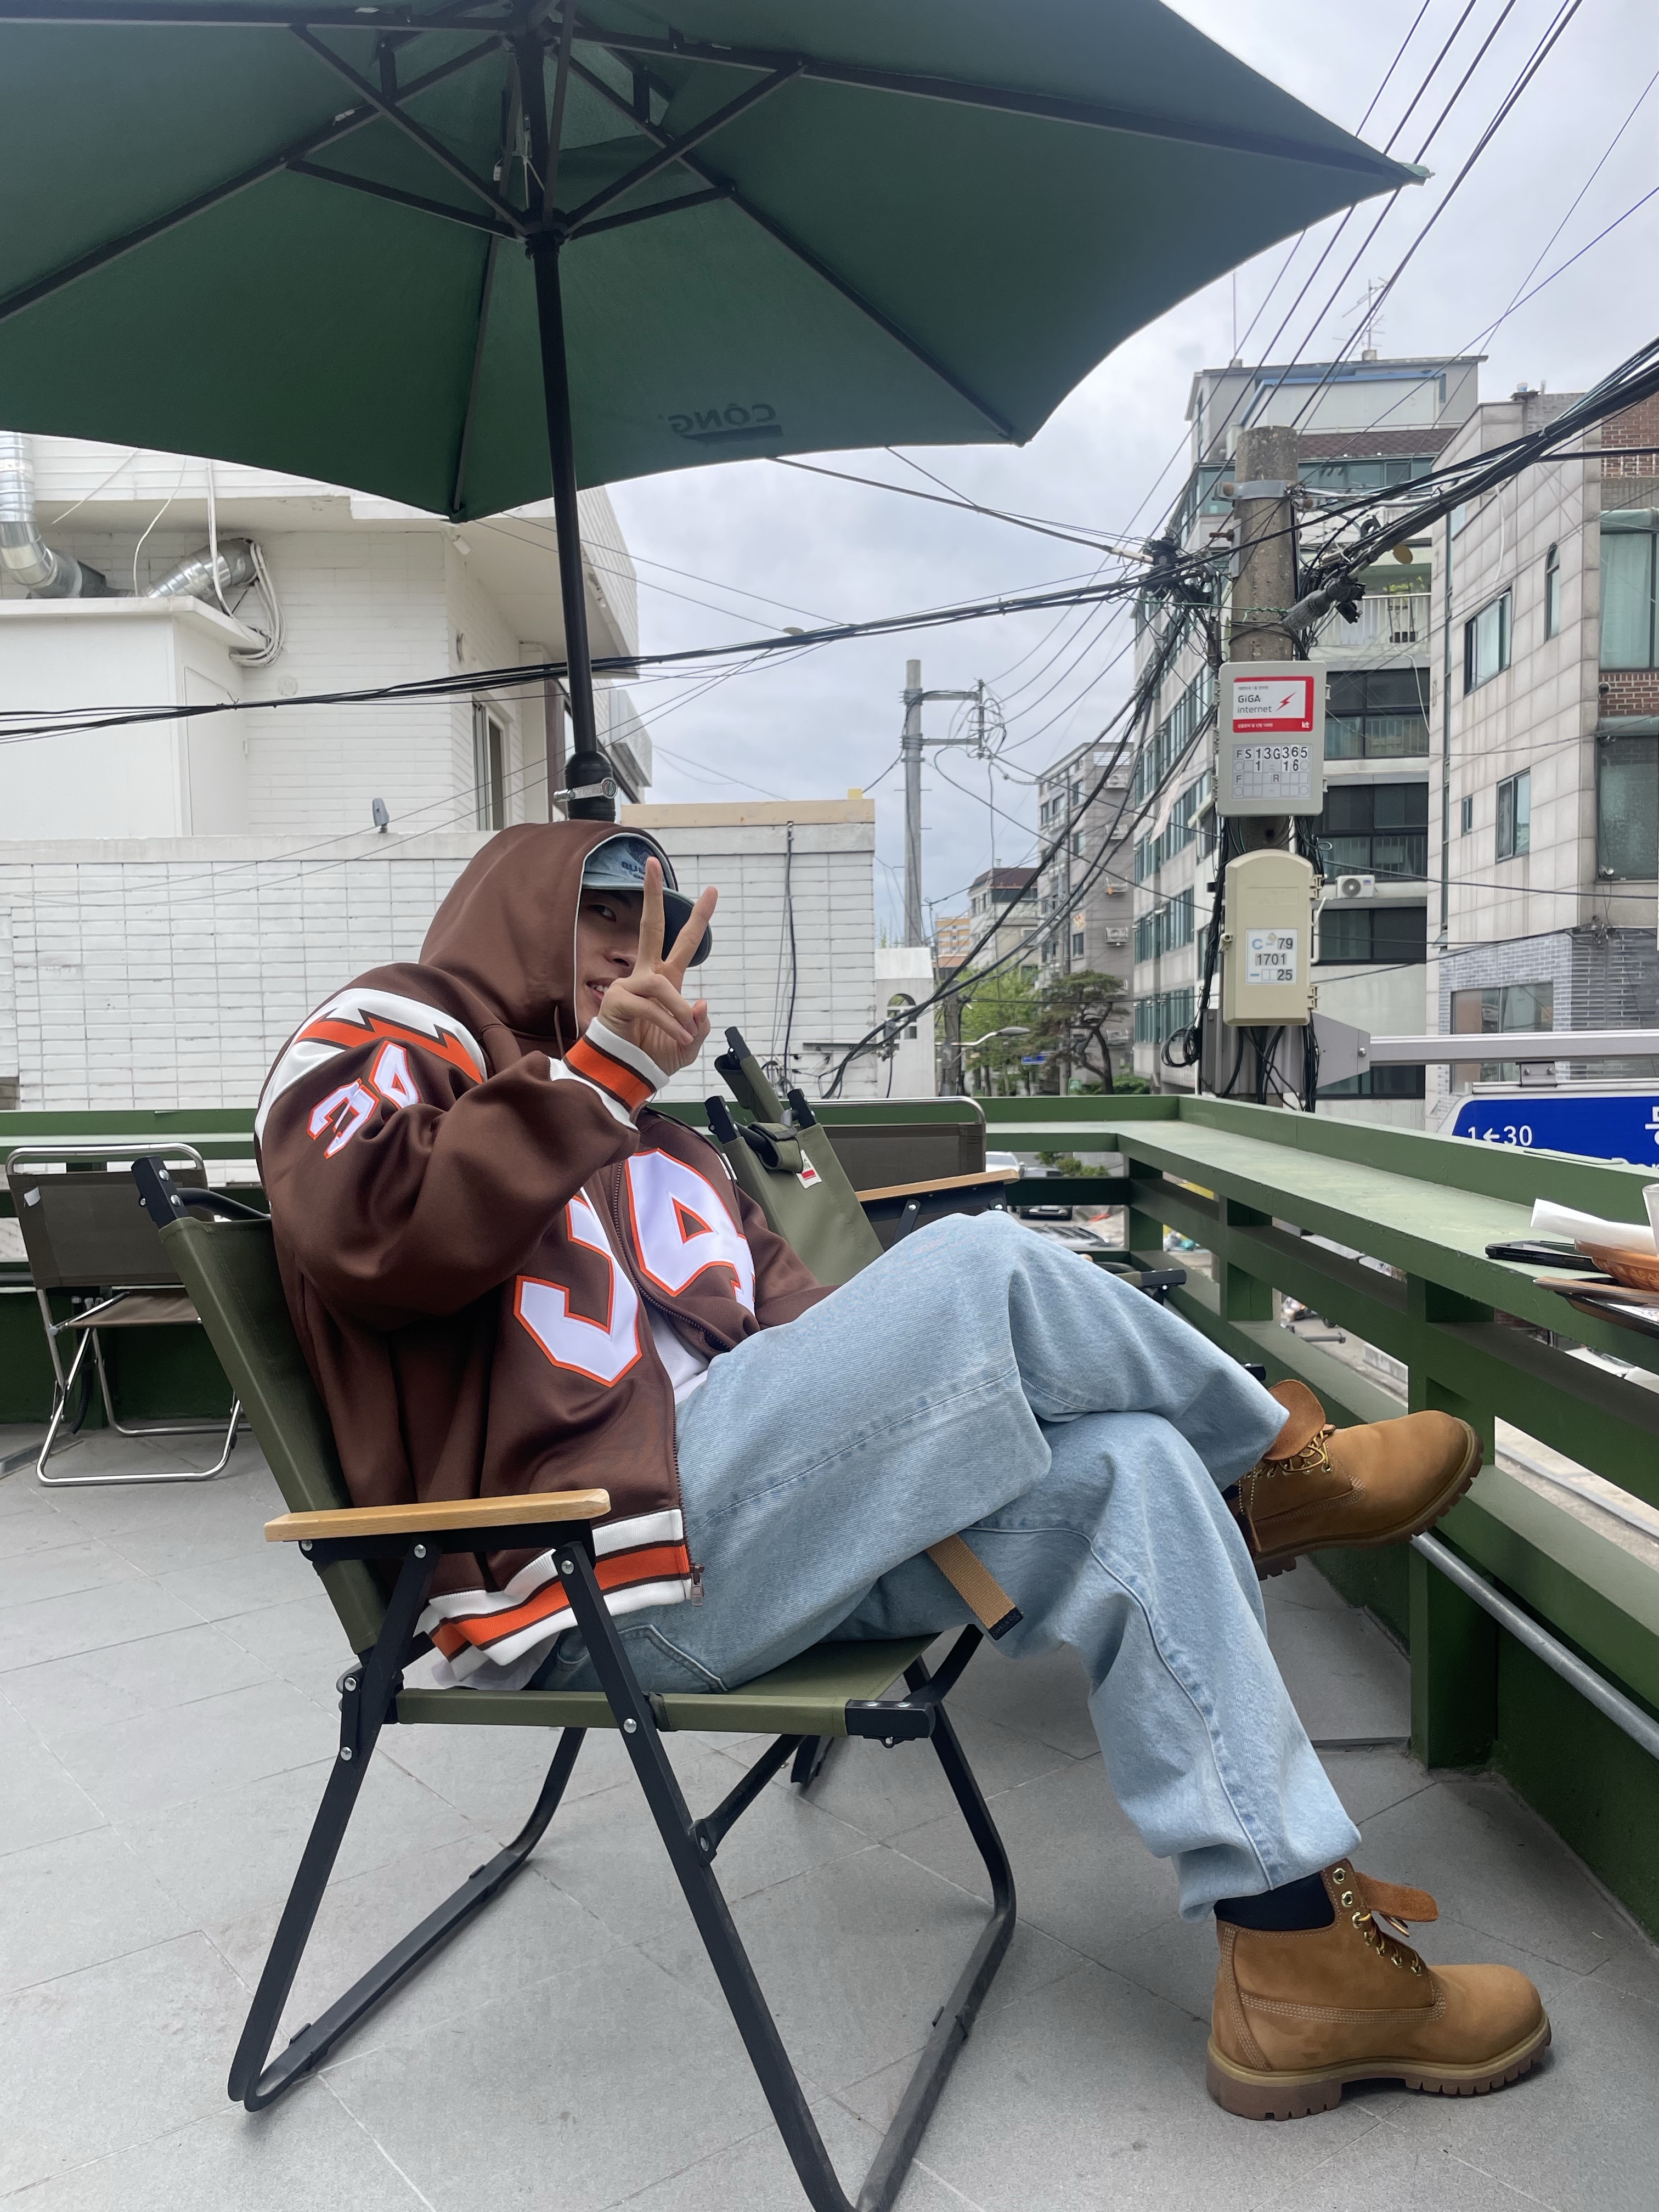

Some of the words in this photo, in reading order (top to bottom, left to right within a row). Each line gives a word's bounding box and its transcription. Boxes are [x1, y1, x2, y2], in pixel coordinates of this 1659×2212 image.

[1278, 938, 1293, 950] 79
[1256, 953, 1285, 966] 1701
[1278, 969, 1293, 981] 25
[1503, 1125, 1532, 1147] 30
